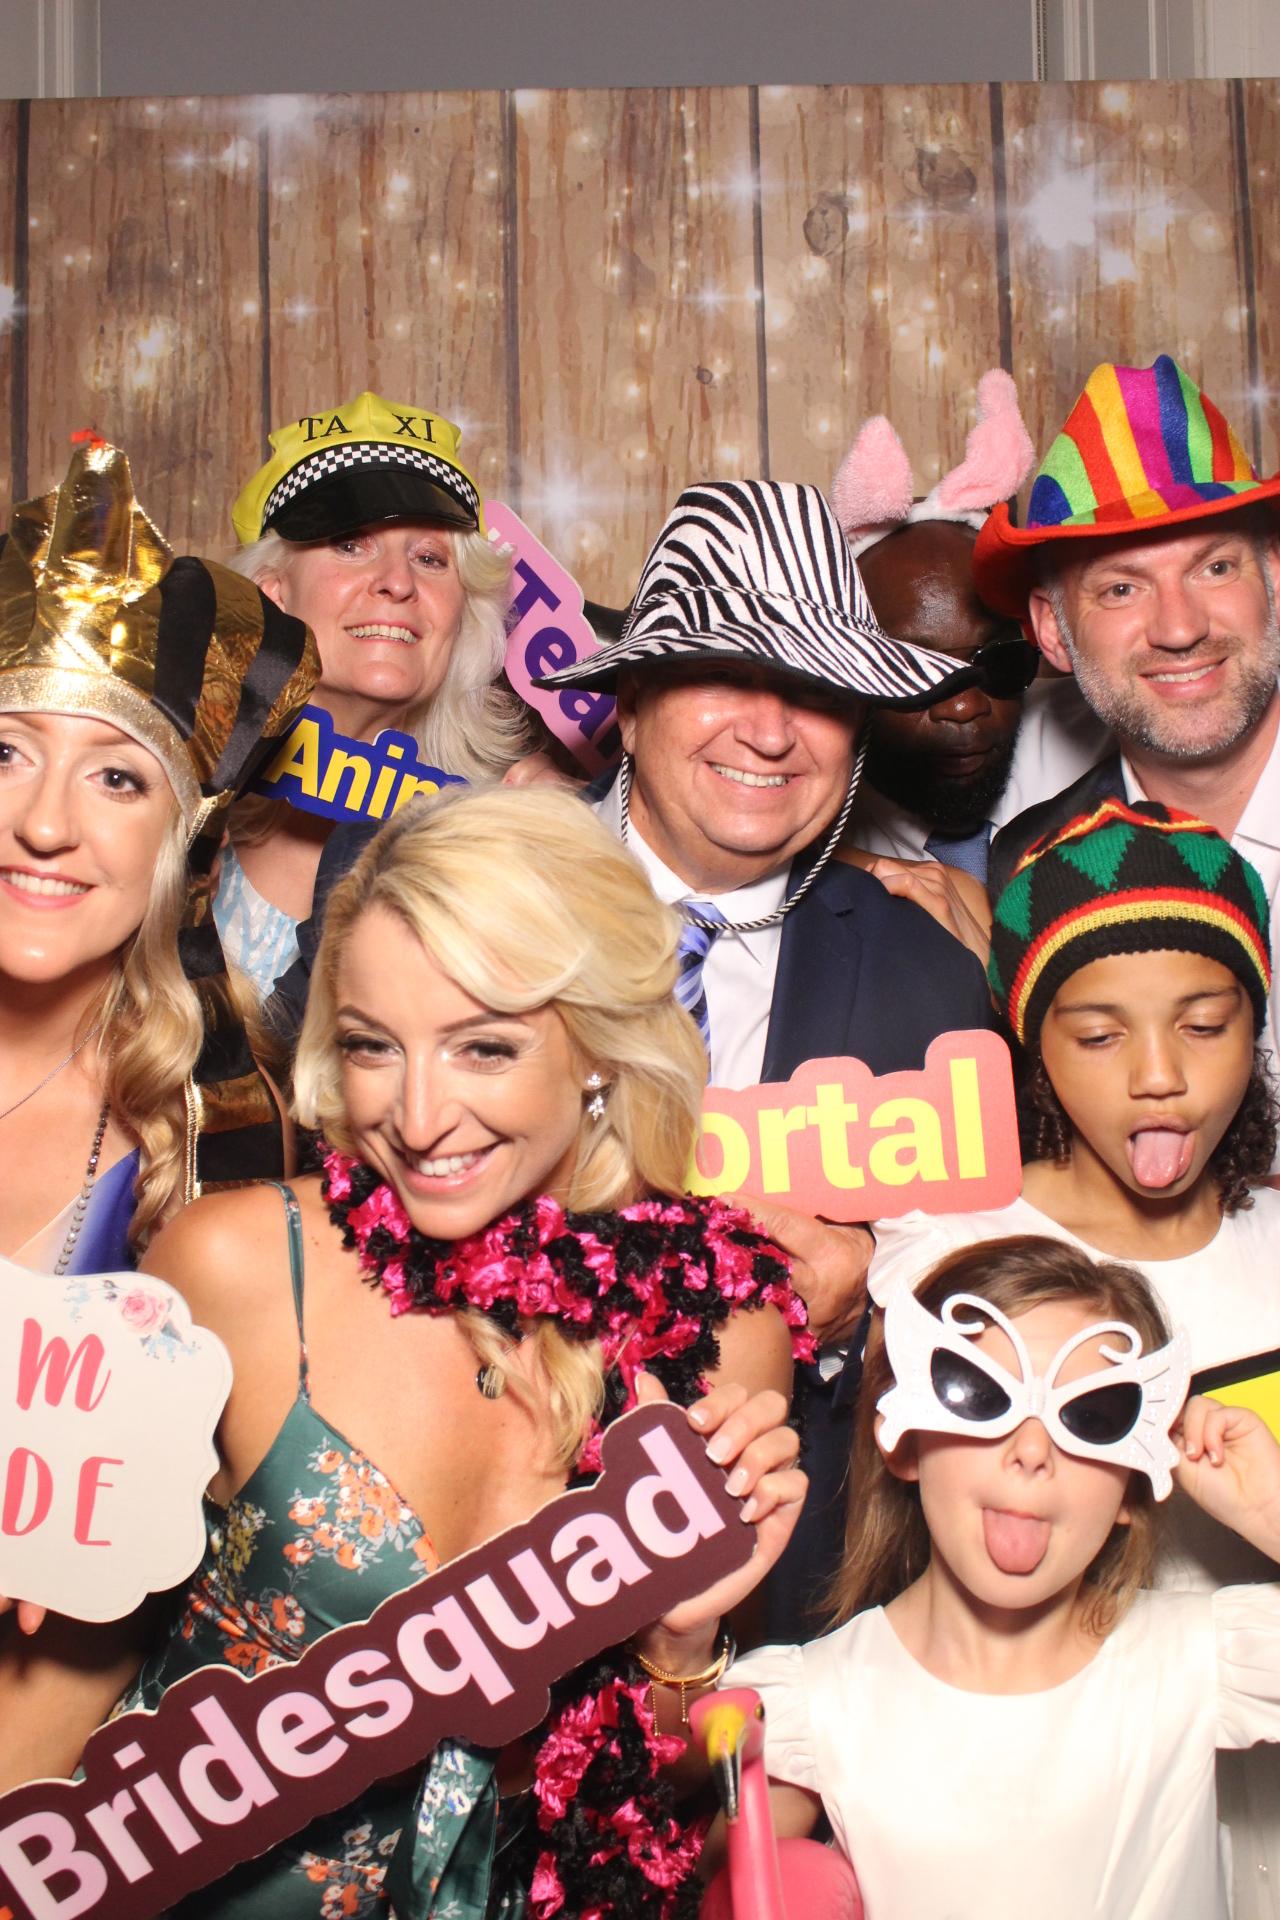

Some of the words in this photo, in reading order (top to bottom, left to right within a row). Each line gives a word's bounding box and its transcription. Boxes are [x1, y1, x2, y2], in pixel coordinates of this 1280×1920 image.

[505, 558, 623, 760] Tea
[1, 1446, 125, 1546] DE
[0, 1424, 728, 1920] Bridesquad
